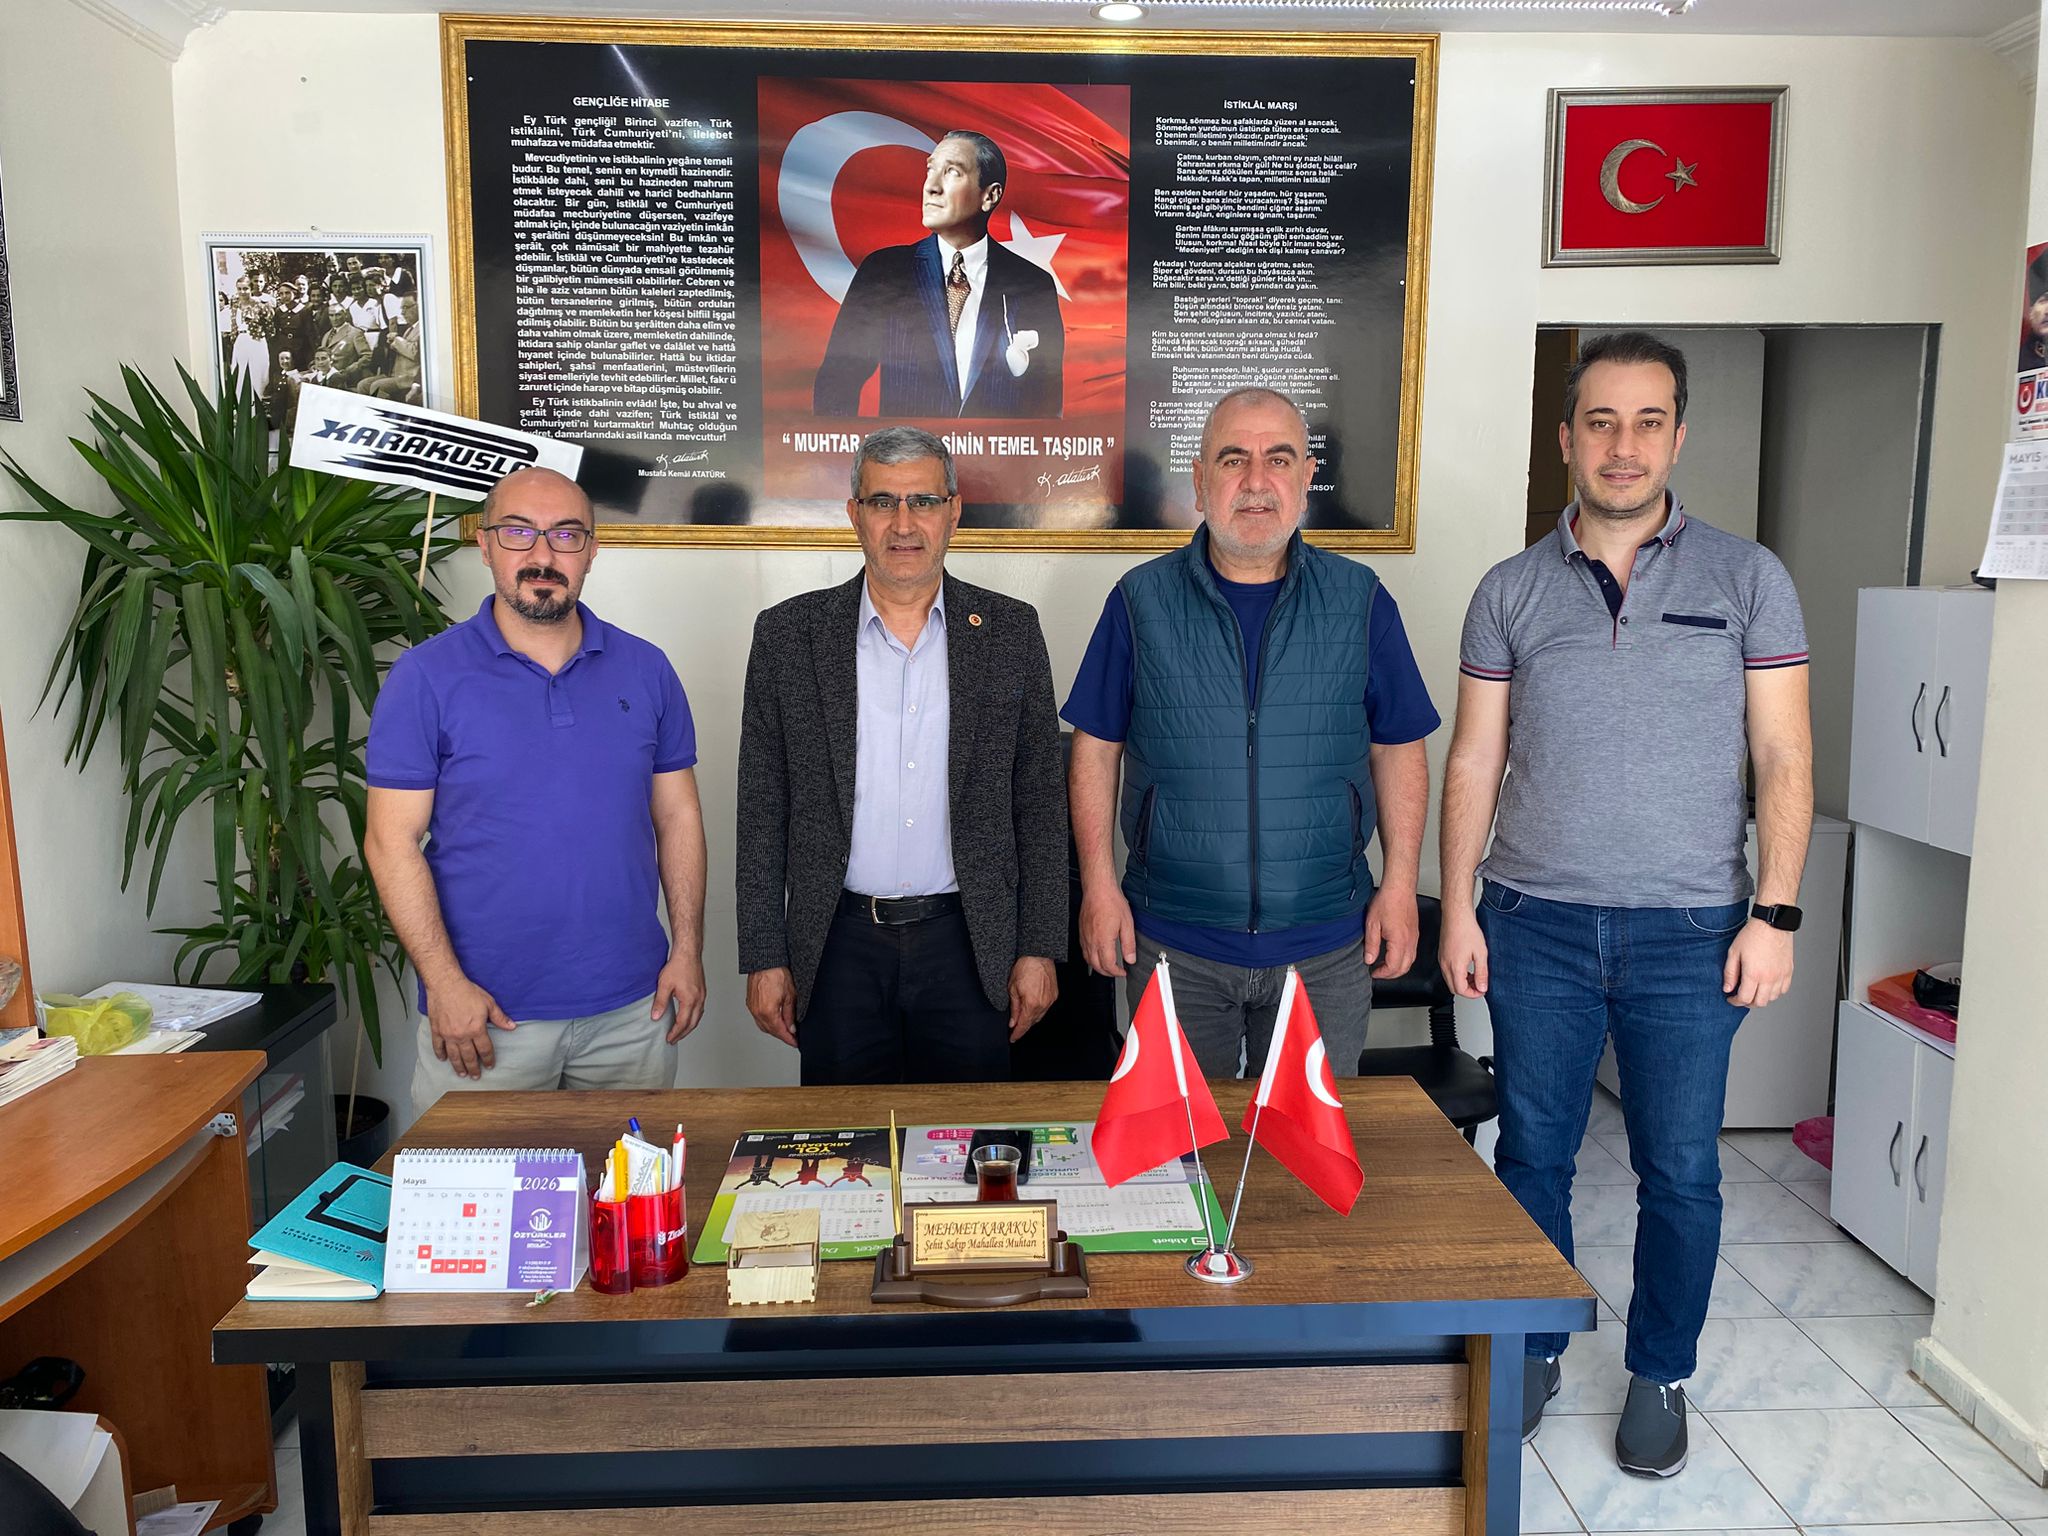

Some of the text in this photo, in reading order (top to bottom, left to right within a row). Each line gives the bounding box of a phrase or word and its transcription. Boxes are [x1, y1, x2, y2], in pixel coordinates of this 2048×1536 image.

[573, 96, 669, 109] GENÇLİĞE HİTABE
[523, 115, 537, 126] Ey
[544, 116, 567, 125] Türk
[625, 117, 657, 126] Birinci
[710, 118, 732, 128] Türk
[571, 127, 596, 136] Türk
[511, 138, 558, 147] muhafaza
[571, 138, 613, 148] müdafaa
[525, 153, 598, 165] Mevcudiyetinin
[613, 155, 665, 164] istikbalinin
[703, 156, 732, 165] temeli
[546, 165, 560, 174] Bu
[595, 165, 622, 175] senin
[640, 166, 678, 178] kıymetli
[594, 176, 615, 186] seni
[620, 177, 633, 186] bu
[639, 177, 688, 187] hazineden
[694, 178, 733, 187] mahrum
[513, 186, 543, 196] etmek
[547, 187, 593, 198] isteyecek
[677, 189, 733, 198] bedhahların
[565, 198, 580, 207] Bir
[675, 200, 733, 212] Cumhuriyeti
[516, 274, 530, 283] bir
[532, 274, 581, 286] galibiyetin
[584, 275, 633, 285] mümessili
[686, 277, 720, 286] Cebren
[516, 285, 534, 294] hile
[536, 285, 548, 294] ile
[551, 286, 570, 295] aziz
[572, 286, 608, 295] vatanın
[610, 286, 638, 296] bütün
[641, 287, 676, 296] kaleleri
[532, 397, 545, 408] Ey
[547, 397, 570, 406] Türk
[572, 398, 623, 407] istikbalinin
[682, 400, 695, 409] bu
[697, 400, 723, 409] ahval
[553, 408, 582, 419] içinde
[588, 408, 609, 418] dahi
[659, 410, 682, 419] Türk
[659, 420, 694, 432] Muhtaç
[698, 421, 737, 433] olduğun
[554, 429, 624, 439] damarlarındaki
[626, 430, 642, 439] asil
[644, 431, 672, 440] kanda
[794, 433, 860, 453] MUHTAR
[988, 436, 1039, 456] TEMEL
[1043, 437, 1104, 461] TAŞIDIR
[638, 468, 667, 477] Mustafa
[692, 469, 726, 478] ATATÜRK
[403, 1177, 427, 1187] Mayıs
[523, 1177, 558, 1191] 2026
[513, 1230, 567, 1239] ÖZTÜRKLER
[924, 1219, 1038, 1238] MEHMET KARAKUŞ
[924, 1239, 943, 1253] Şehit
[967, 1237, 1004, 1249] Mahallesi
